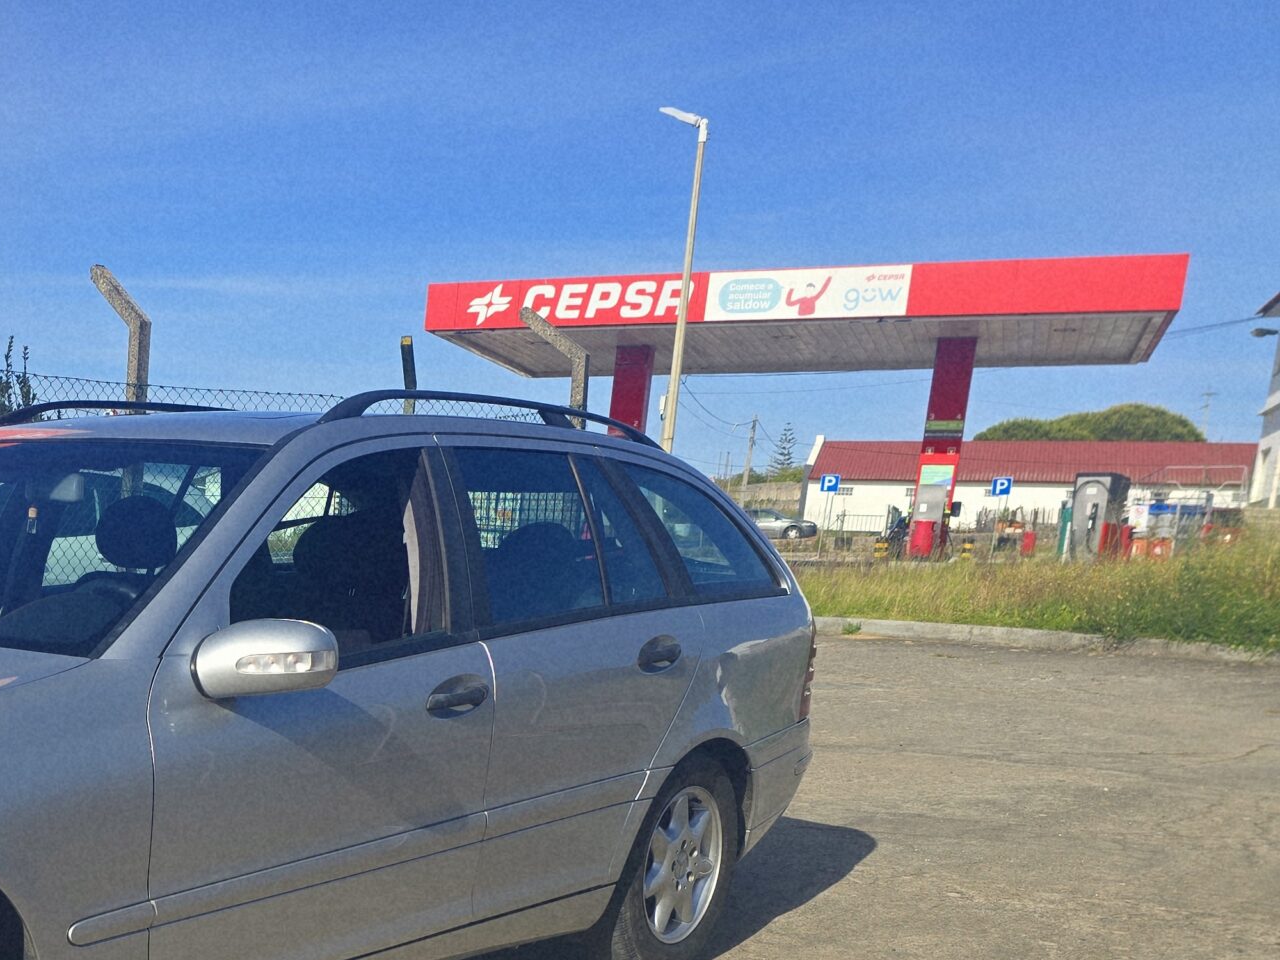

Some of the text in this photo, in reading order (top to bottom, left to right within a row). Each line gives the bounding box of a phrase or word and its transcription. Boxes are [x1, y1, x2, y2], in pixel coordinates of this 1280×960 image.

[877, 273, 905, 281] CEPSA
[729, 283, 766, 291] Comece
[522, 279, 695, 319] CEPSA
[728, 291, 772, 299] acumular
[823, 476, 836, 491] P
[995, 479, 1009, 495] P
